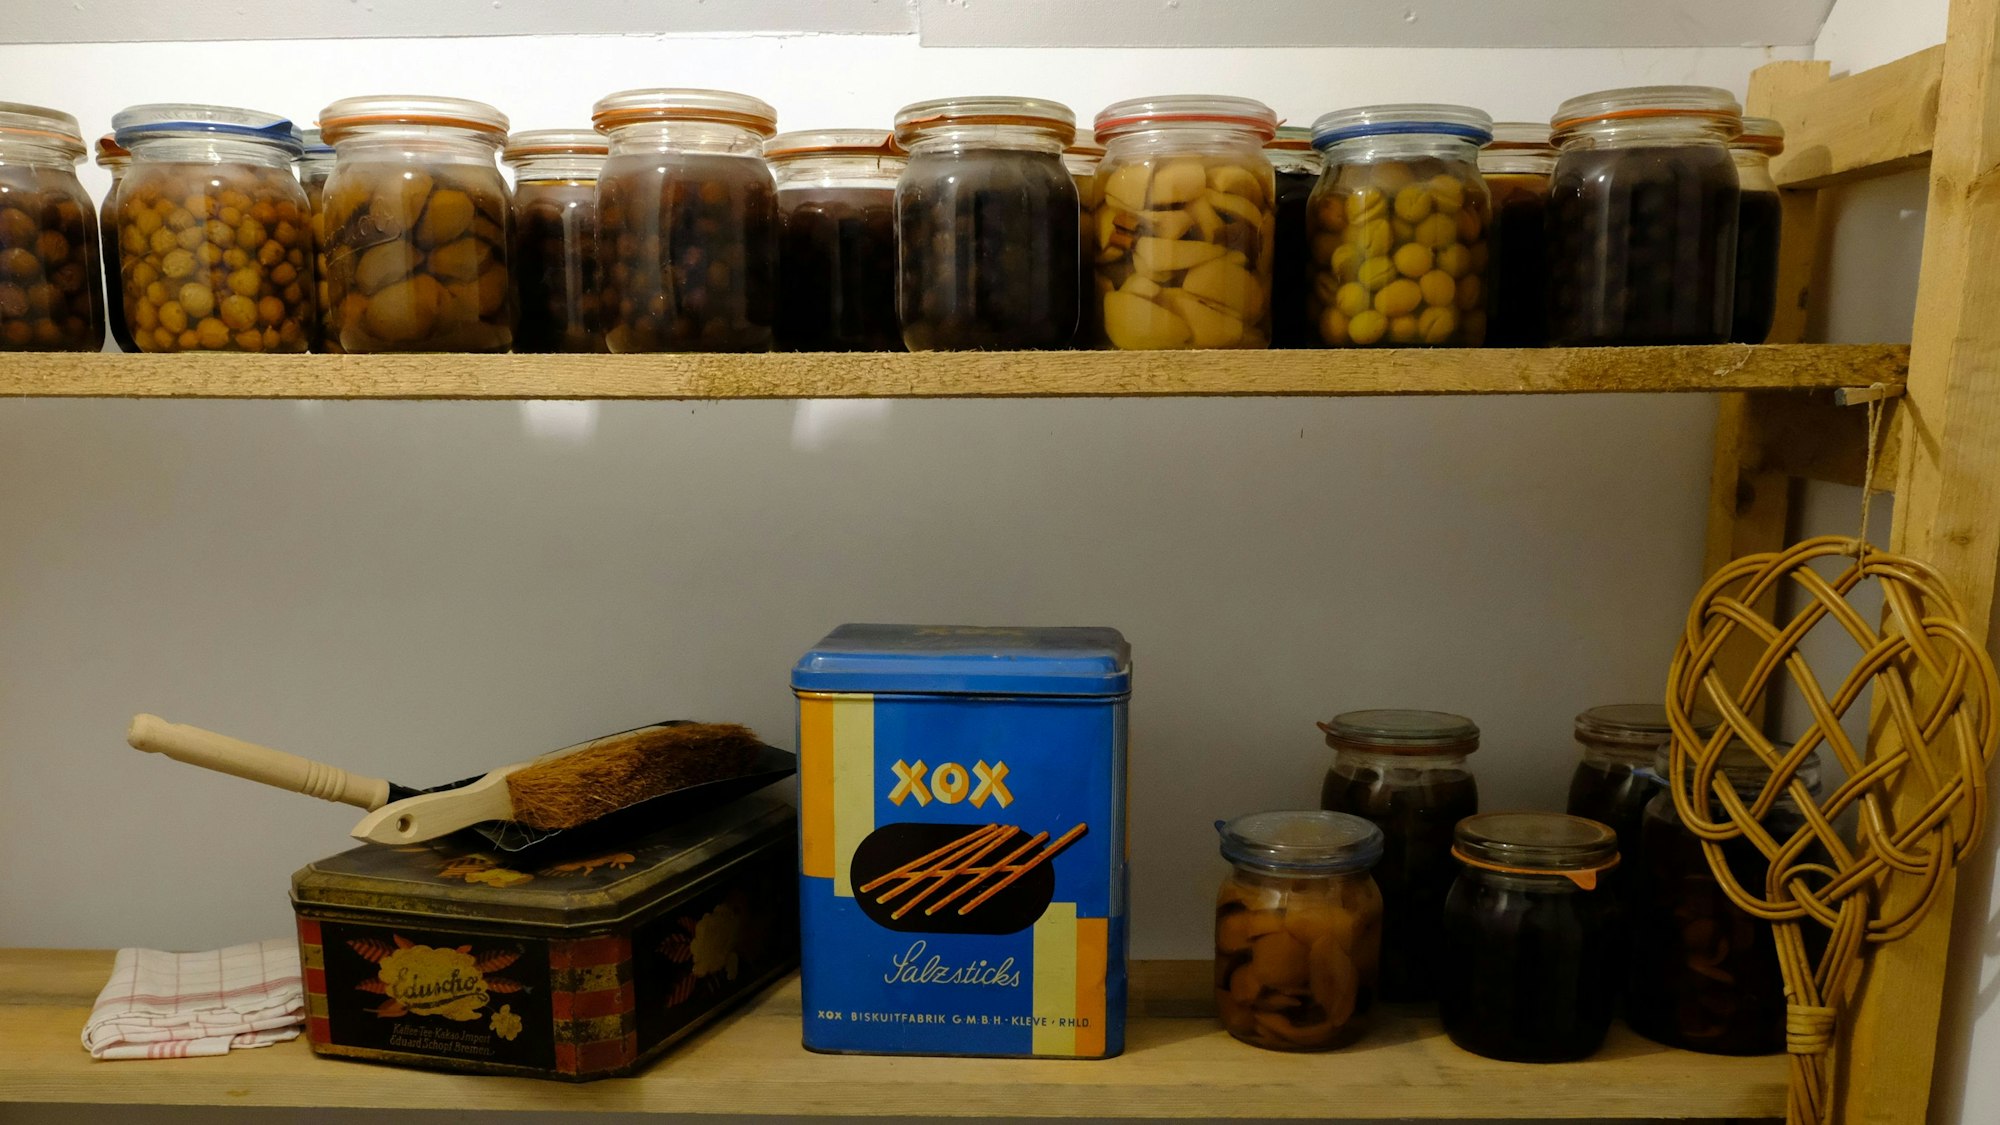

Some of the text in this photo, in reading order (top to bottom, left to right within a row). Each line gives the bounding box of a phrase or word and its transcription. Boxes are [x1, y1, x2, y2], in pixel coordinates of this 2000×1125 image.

[887, 759, 1016, 809] XOX
[884, 940, 1021, 987] Salzsticks
[817, 1010, 843, 1021] XOX
[850, 1011, 946, 1024] BISKUITFABRIK
[1011, 1015, 1047, 1026] KLEVE
[389, 1034, 421, 1049] Eduard
